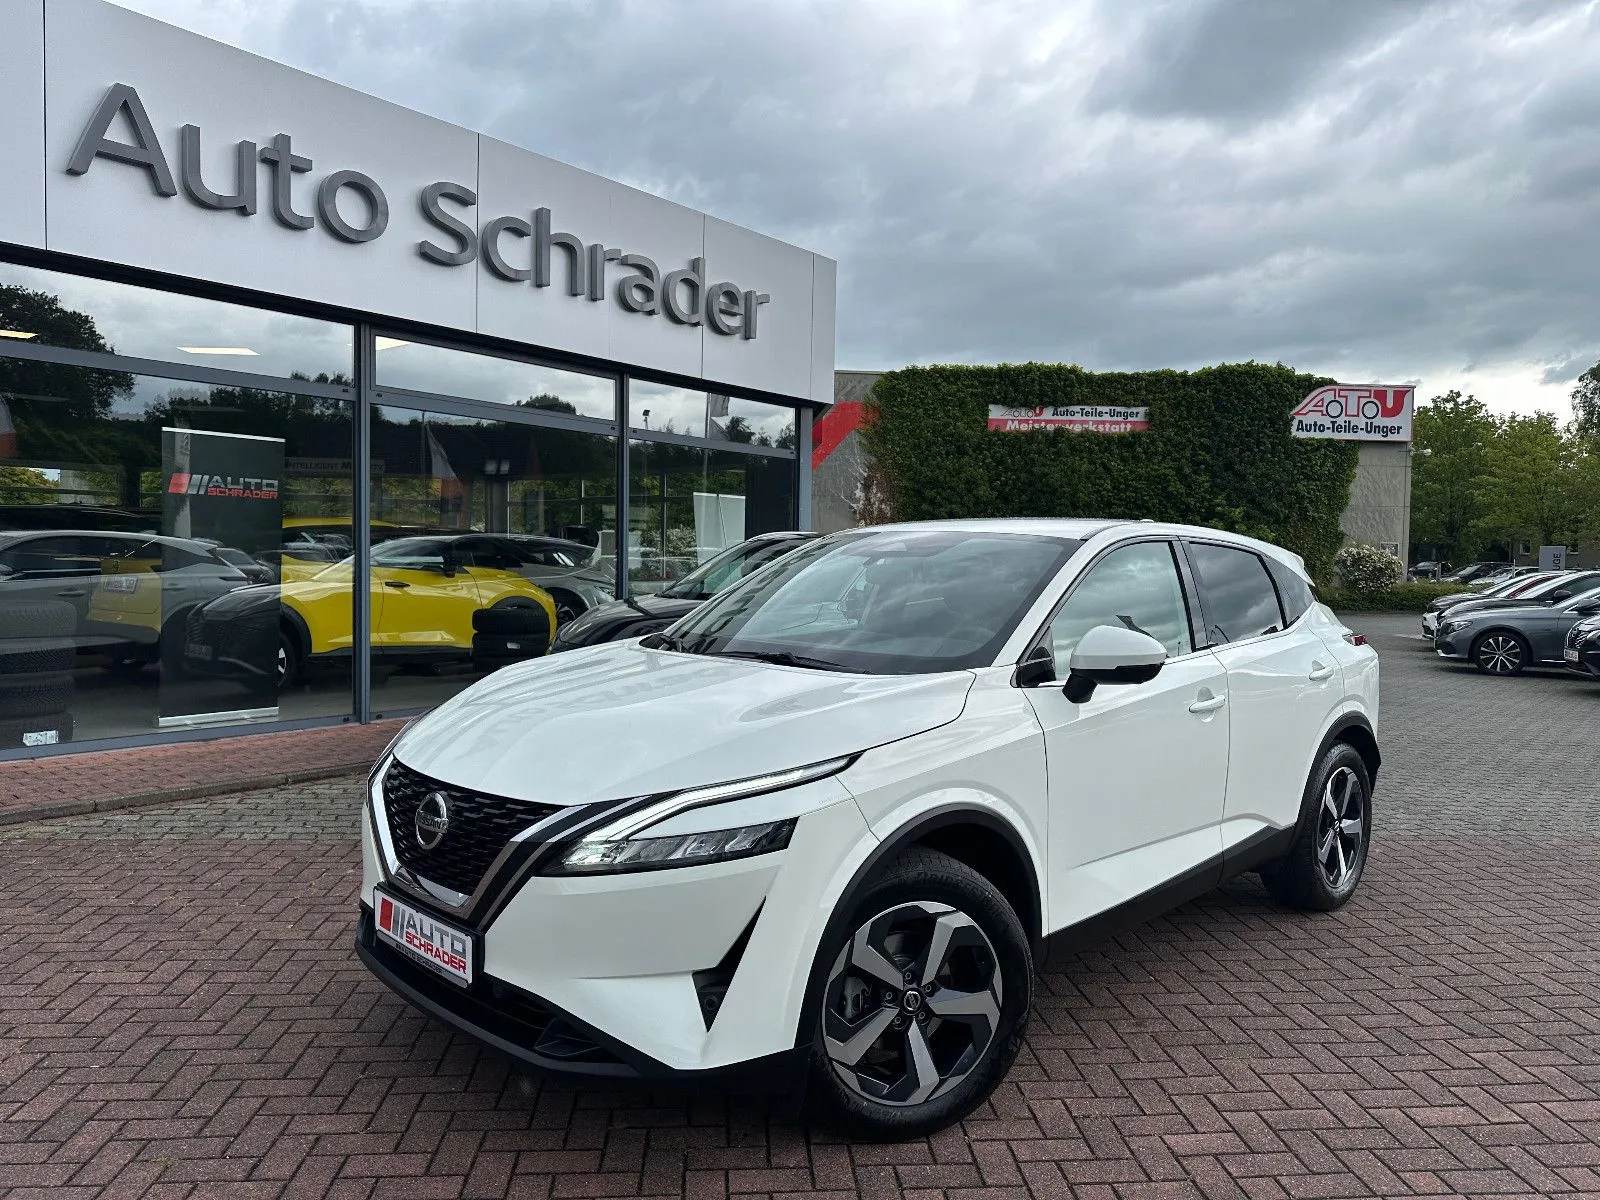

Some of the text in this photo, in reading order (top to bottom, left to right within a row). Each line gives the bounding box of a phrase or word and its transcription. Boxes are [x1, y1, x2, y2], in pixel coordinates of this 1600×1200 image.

[67, 83, 770, 340] Auto Schrader
[1052, 407, 1140, 420] Auto-Teile-Unger
[1296, 420, 1402, 437] Auto-Teile-Unger
[208, 475, 279, 492] AUTO
[207, 487, 278, 500] SCHRADER
[405, 912, 467, 959] AUTO
[405, 931, 467, 974] SCHRADER
